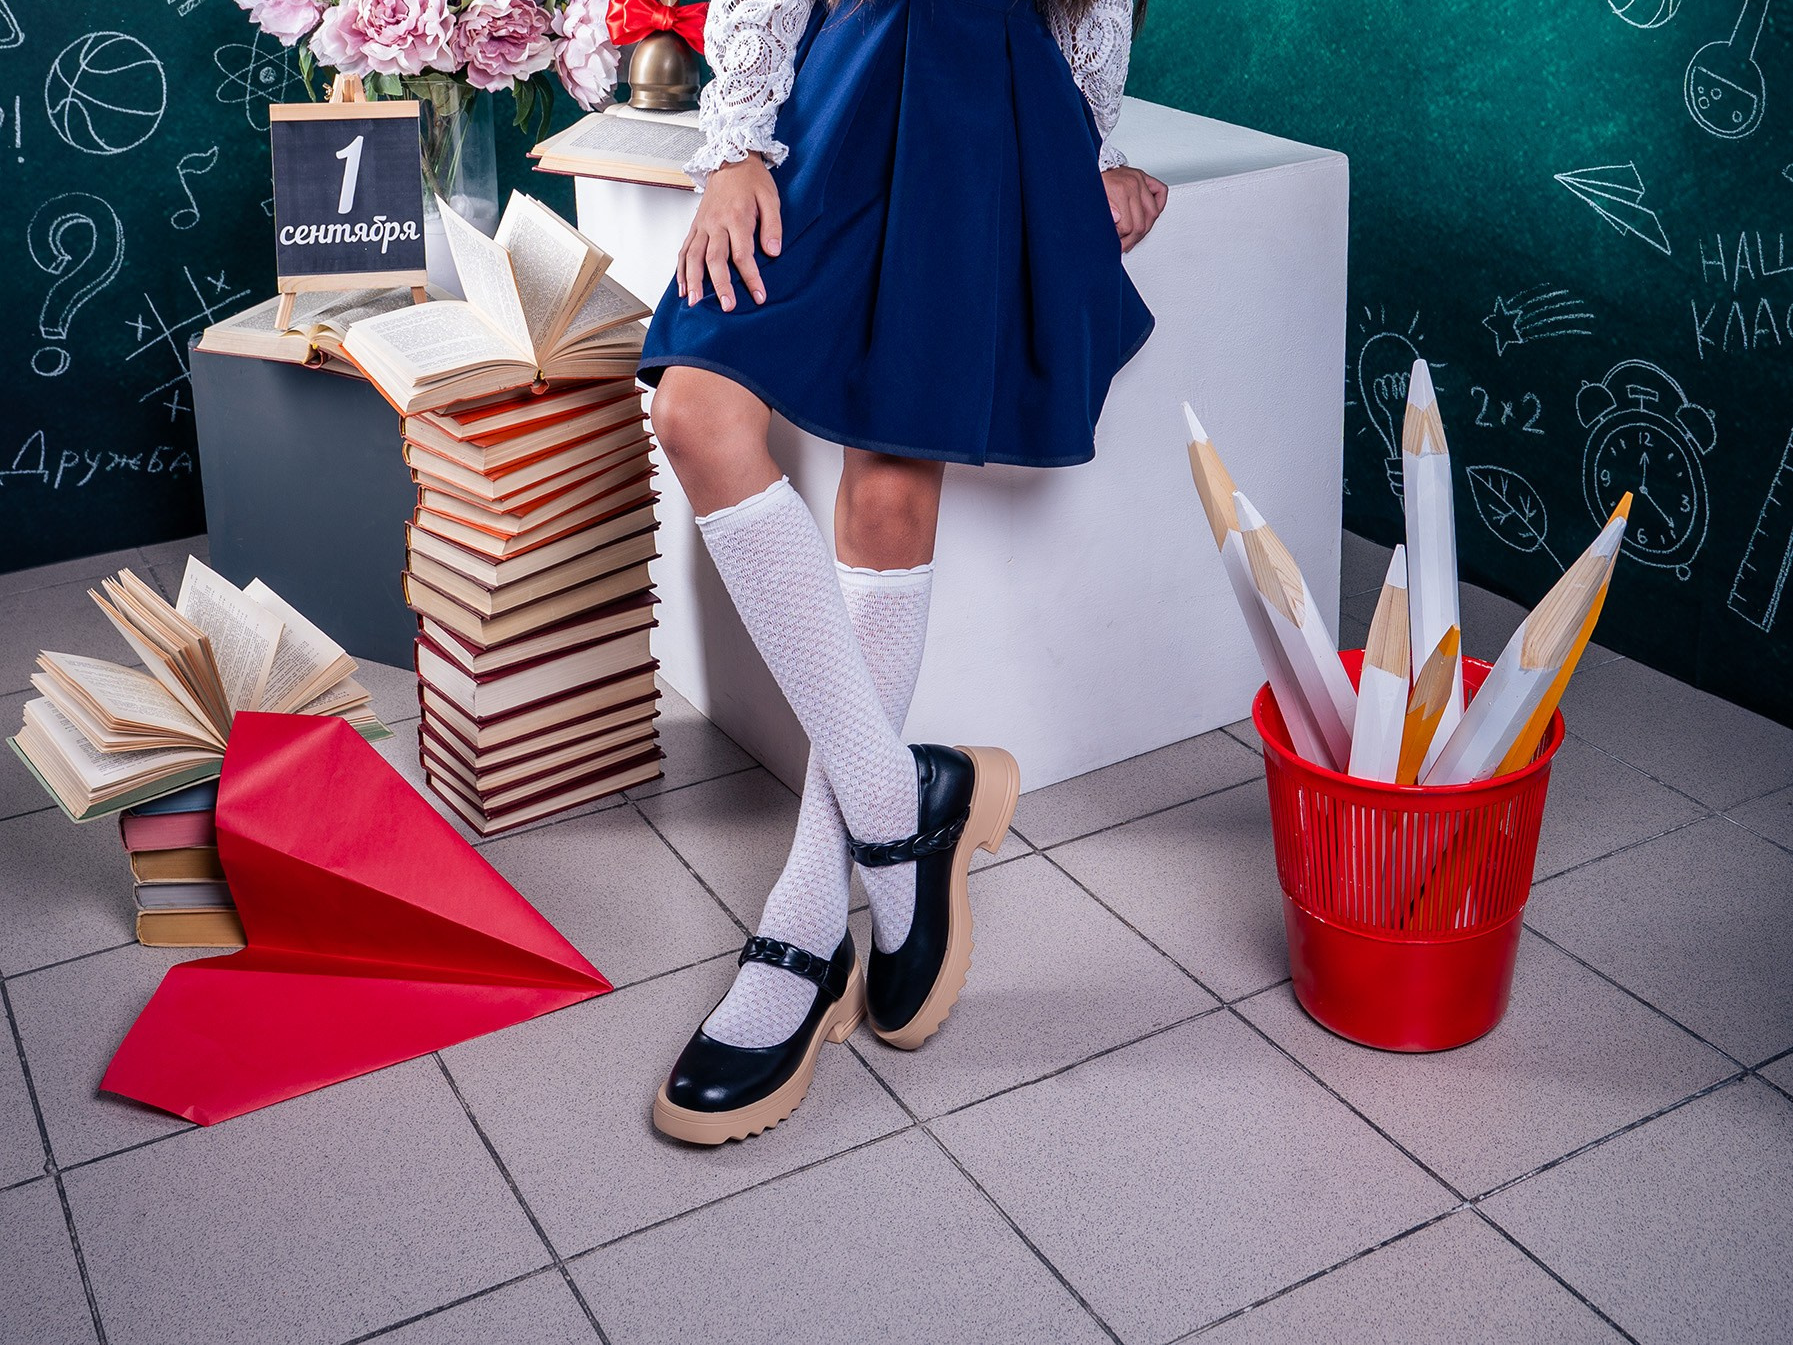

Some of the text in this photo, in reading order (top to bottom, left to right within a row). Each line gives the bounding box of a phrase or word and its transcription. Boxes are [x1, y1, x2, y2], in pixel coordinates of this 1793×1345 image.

[335, 135, 364, 214] 1
[279, 215, 421, 254] сентября
[1638, 431, 1654, 447] 12
[1600, 469, 1611, 487] 9
[1680, 494, 1691, 513] 3
[1637, 528, 1648, 544] 6
